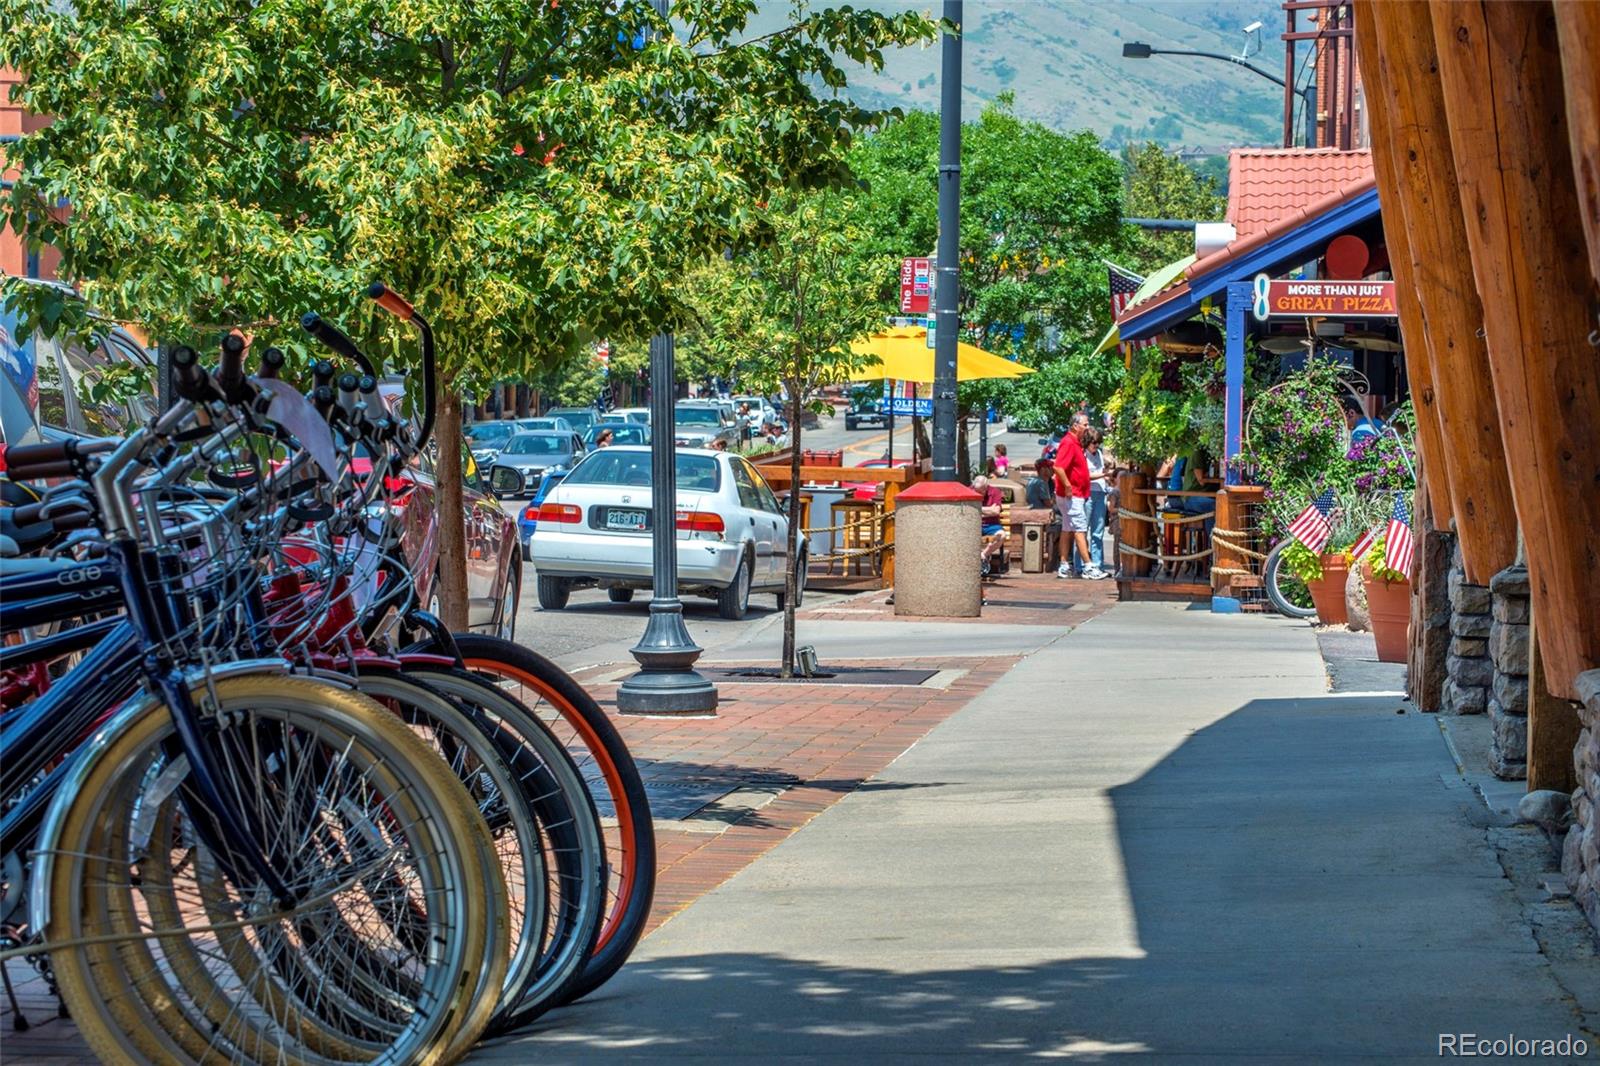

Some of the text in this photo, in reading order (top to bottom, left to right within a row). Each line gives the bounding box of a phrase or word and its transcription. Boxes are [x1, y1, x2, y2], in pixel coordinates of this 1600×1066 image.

[902, 259, 912, 311] The Ride
[1288, 285, 1384, 296] MORE THAN JUST
[1277, 297, 1393, 311] GREAT PIZZA
